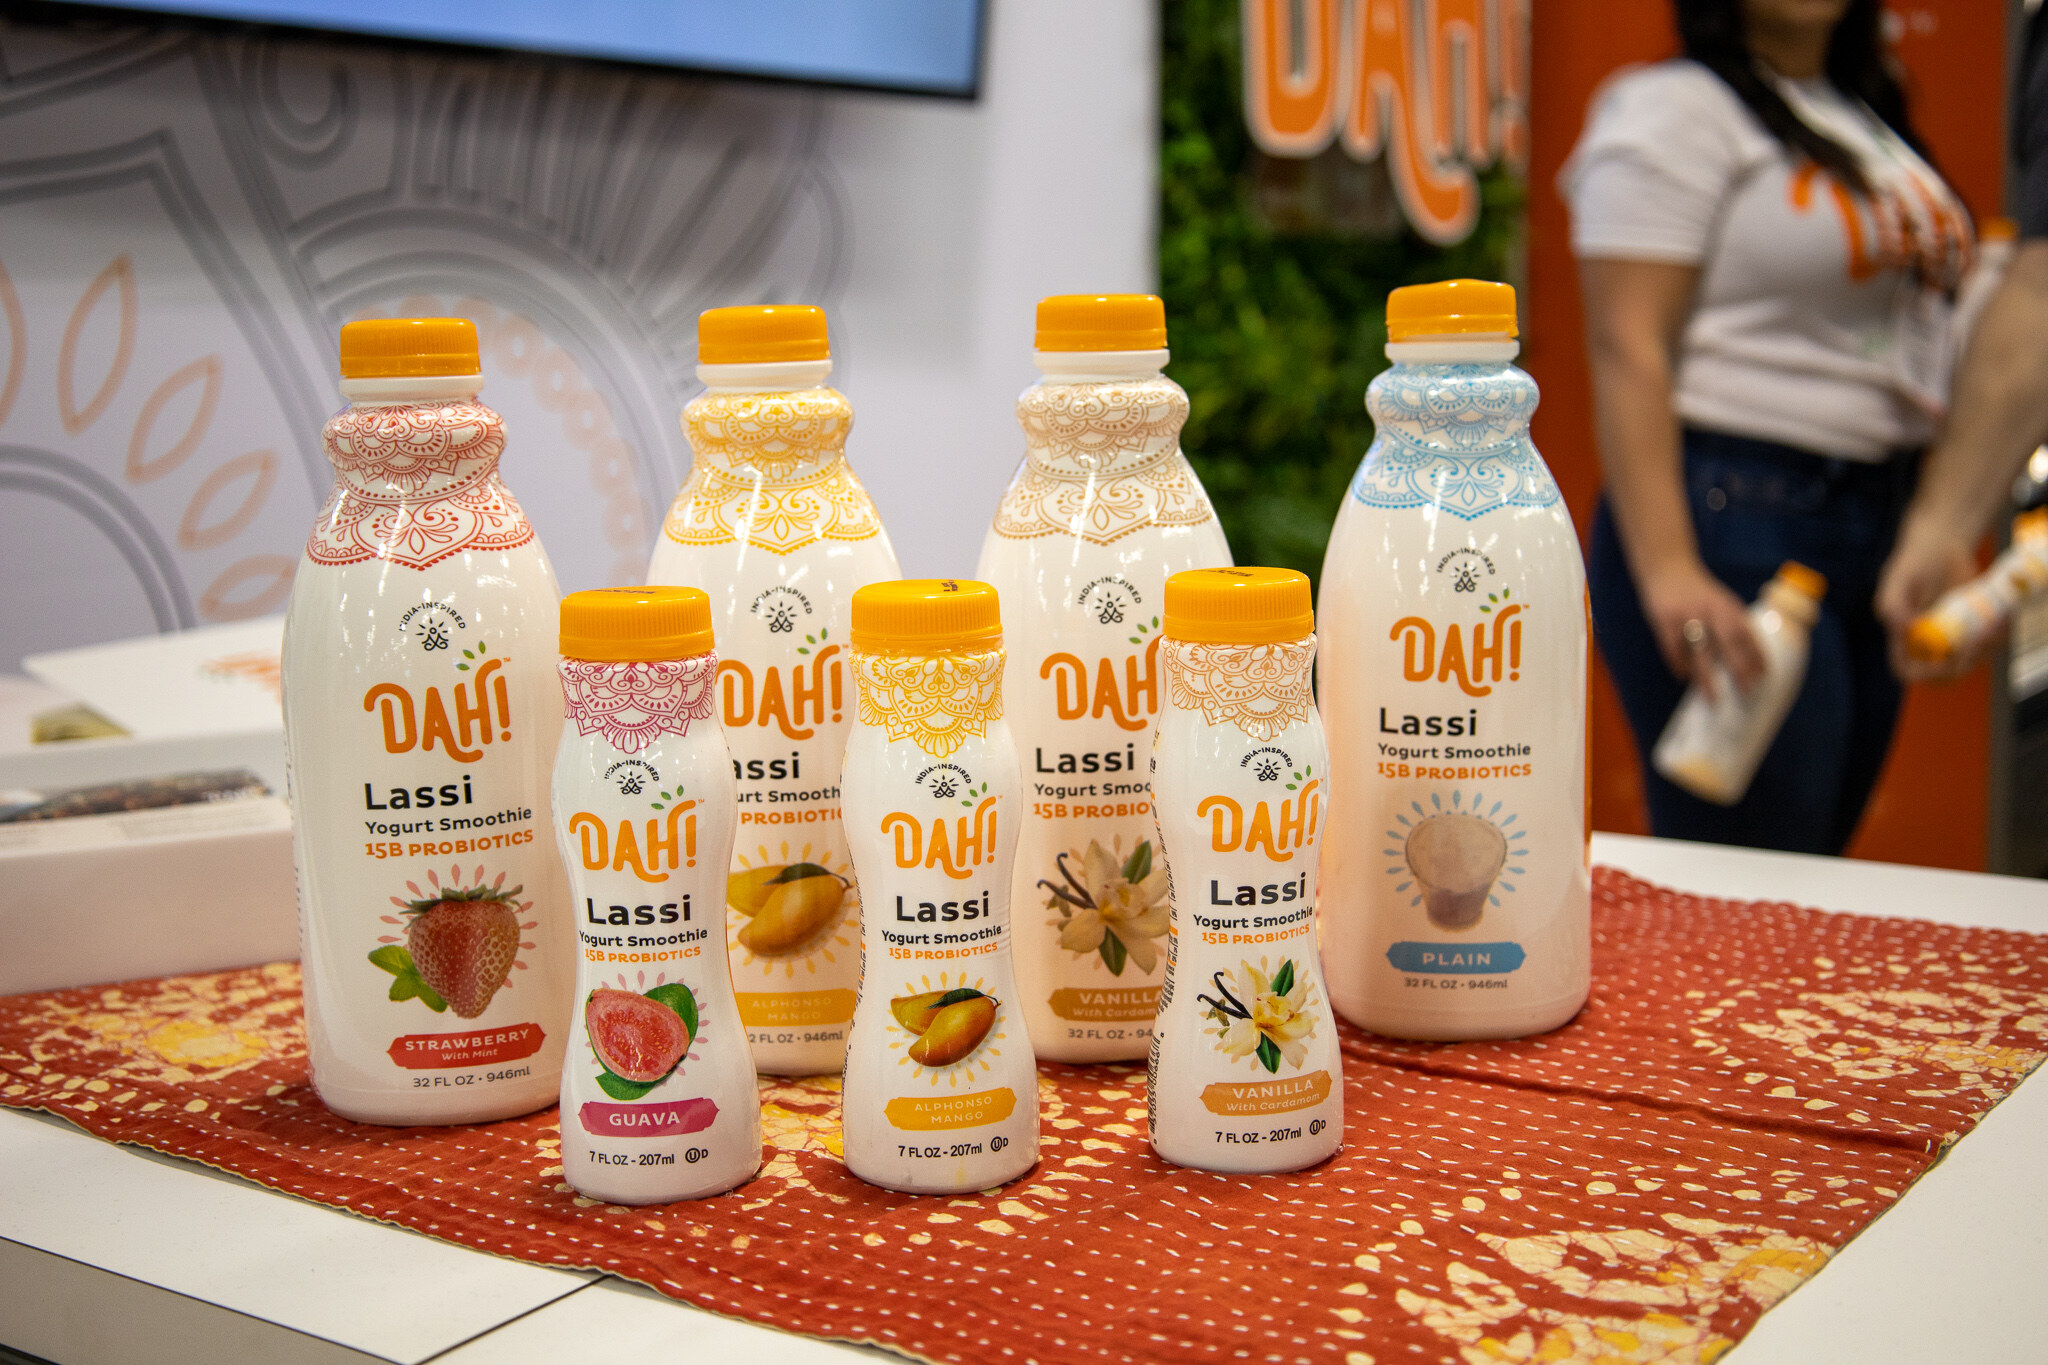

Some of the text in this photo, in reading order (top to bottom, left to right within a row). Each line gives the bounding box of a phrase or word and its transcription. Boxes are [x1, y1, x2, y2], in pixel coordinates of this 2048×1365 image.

[1389, 604, 1522, 697] DAH!
[715, 644, 842, 740] DAH!
[1040, 634, 1164, 731] DAH
[363, 658, 512, 763] DAH!
[1379, 707, 1477, 736] Lassi
[1036, 743, 1134, 773] Lassi
[1240, 747, 1293, 768] INDIA-INSPIRED
[1378, 743, 1531, 760] Yogurt Smoothie
[915, 763, 972, 784] INDIA-INSPIRED
[1377, 762, 1532, 780] 15B PROBIOTICS
[364, 774, 473, 810] Lassi
[1034, 783, 1097, 799] Yogurt
[1033, 803, 1068, 819] 15B
[1197, 779, 1318, 862] DAH!
[365, 807, 532, 837] Yogurt Smoothie
[365, 829, 534, 859] 15B PROBIOTICS
[569, 800, 696, 883] DAH!
[881, 796, 997, 880] DAH!
[1211, 872, 1306, 905] Lassi
[586, 894, 691, 925] Lassi
[896, 890, 989, 922] Lassi
[1193, 906, 1313, 930] Yogurt Smoothie
[579, 928, 708, 947] Yogurt Smoothie
[882, 925, 1001, 945] Yogurt Smoothie
[1202, 924, 1310, 944] 15B PROBIOTICS
[585, 946, 701, 963] 15B PROBIOTICS
[889, 942, 998, 960] 15B PROBIOTICS
[1422, 952, 1491, 965] PLAIN
[1404, 977, 1419, 987] 32
[1422, 978, 1437, 989] FL
[1440, 979, 1458, 989] OZ
[1468, 979, 1508, 989] 946ml
[752, 998, 832, 1009] ALPHONSO
[1072, 1007, 1102, 1017] With
[768, 1012, 822, 1020] MANGO
[405, 1029, 529, 1051] STRAWBERRY
[759, 1034, 773, 1043] FL
[777, 1033, 793, 1043] OZ
[804, 1030, 843, 1042] 946ml
[1068, 1028, 1083, 1038] 32
[1087, 1029, 1103, 1039] FL
[1106, 1029, 1125, 1039] OZ
[442, 1048, 499, 1061] With Mint
[413, 1078, 430, 1088] 32
[434, 1077, 451, 1086] FL
[455, 1075, 474, 1086] OZ
[486, 1066, 531, 1082] 946ml
[1232, 1079, 1314, 1099] VANILLA
[915, 1096, 992, 1111] ALPHONSO
[1226, 1093, 1320, 1111] With Cardamom
[609, 1112, 680, 1126] GUAVA
[931, 1112, 983, 1124] MANGO
[1215, 1131, 1222, 1142] 7
[1226, 1133, 1240, 1143] FL
[1242, 1132, 1259, 1143] OZ
[1270, 1127, 1301, 1142] 207ml
[589, 1151, 595, 1162] 7
[598, 1154, 610, 1164] FL
[613, 1155, 628, 1165] OZ
[639, 1154, 675, 1165] 207ml
[898, 1146, 905, 1157] 7
[909, 1147, 922, 1157] FL
[925, 1147, 941, 1158] OZ
[950, 1143, 982, 1157] 207ml
